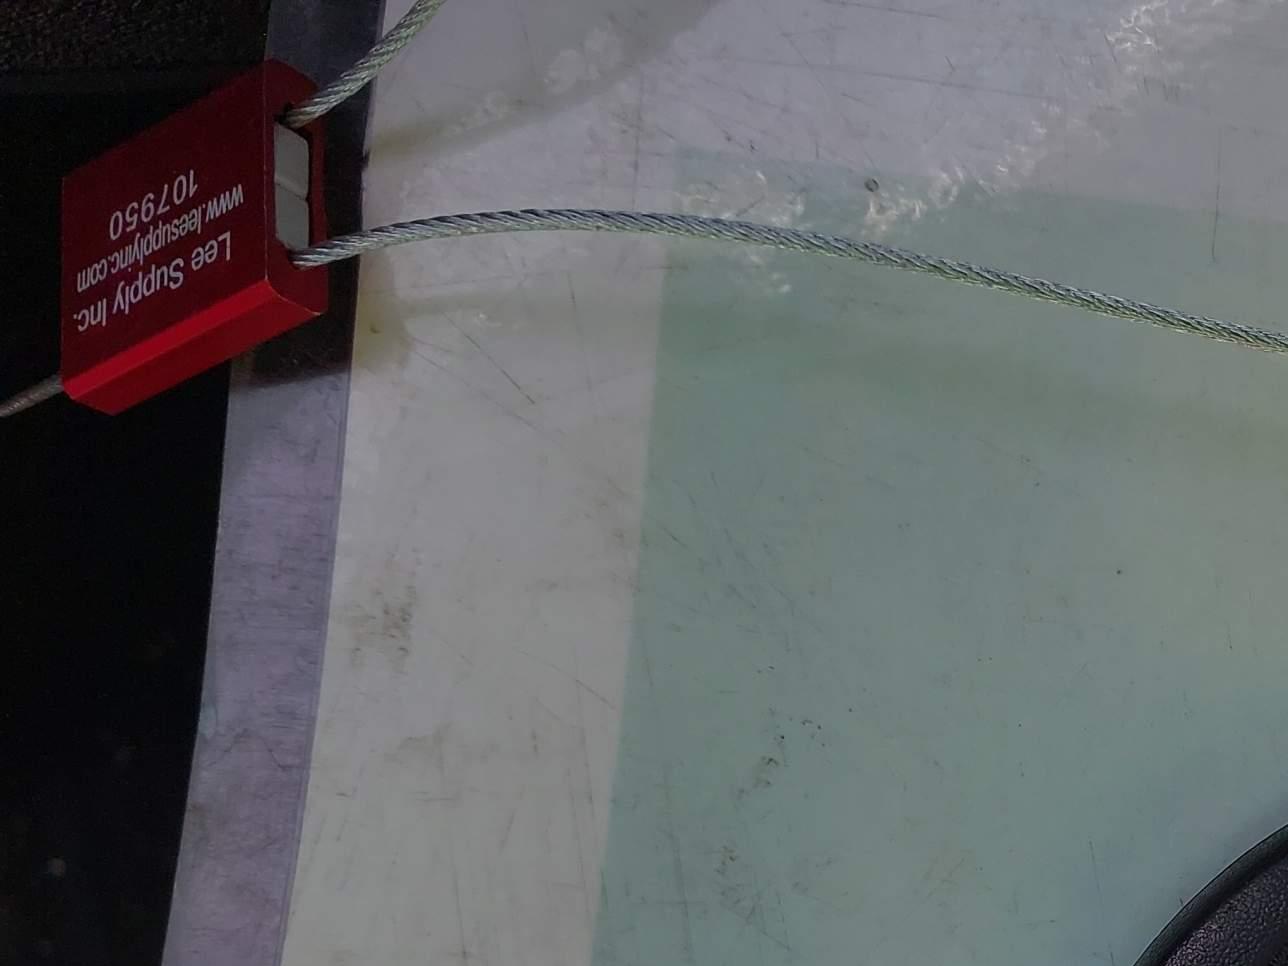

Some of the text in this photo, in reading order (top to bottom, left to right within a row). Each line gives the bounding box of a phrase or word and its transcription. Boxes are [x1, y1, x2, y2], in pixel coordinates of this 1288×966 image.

[77, 183, 244, 293] www.leesupplyinc.com
[109, 169, 198, 241] 107950
[73, 230, 232, 332] Lee Supply Inc.
